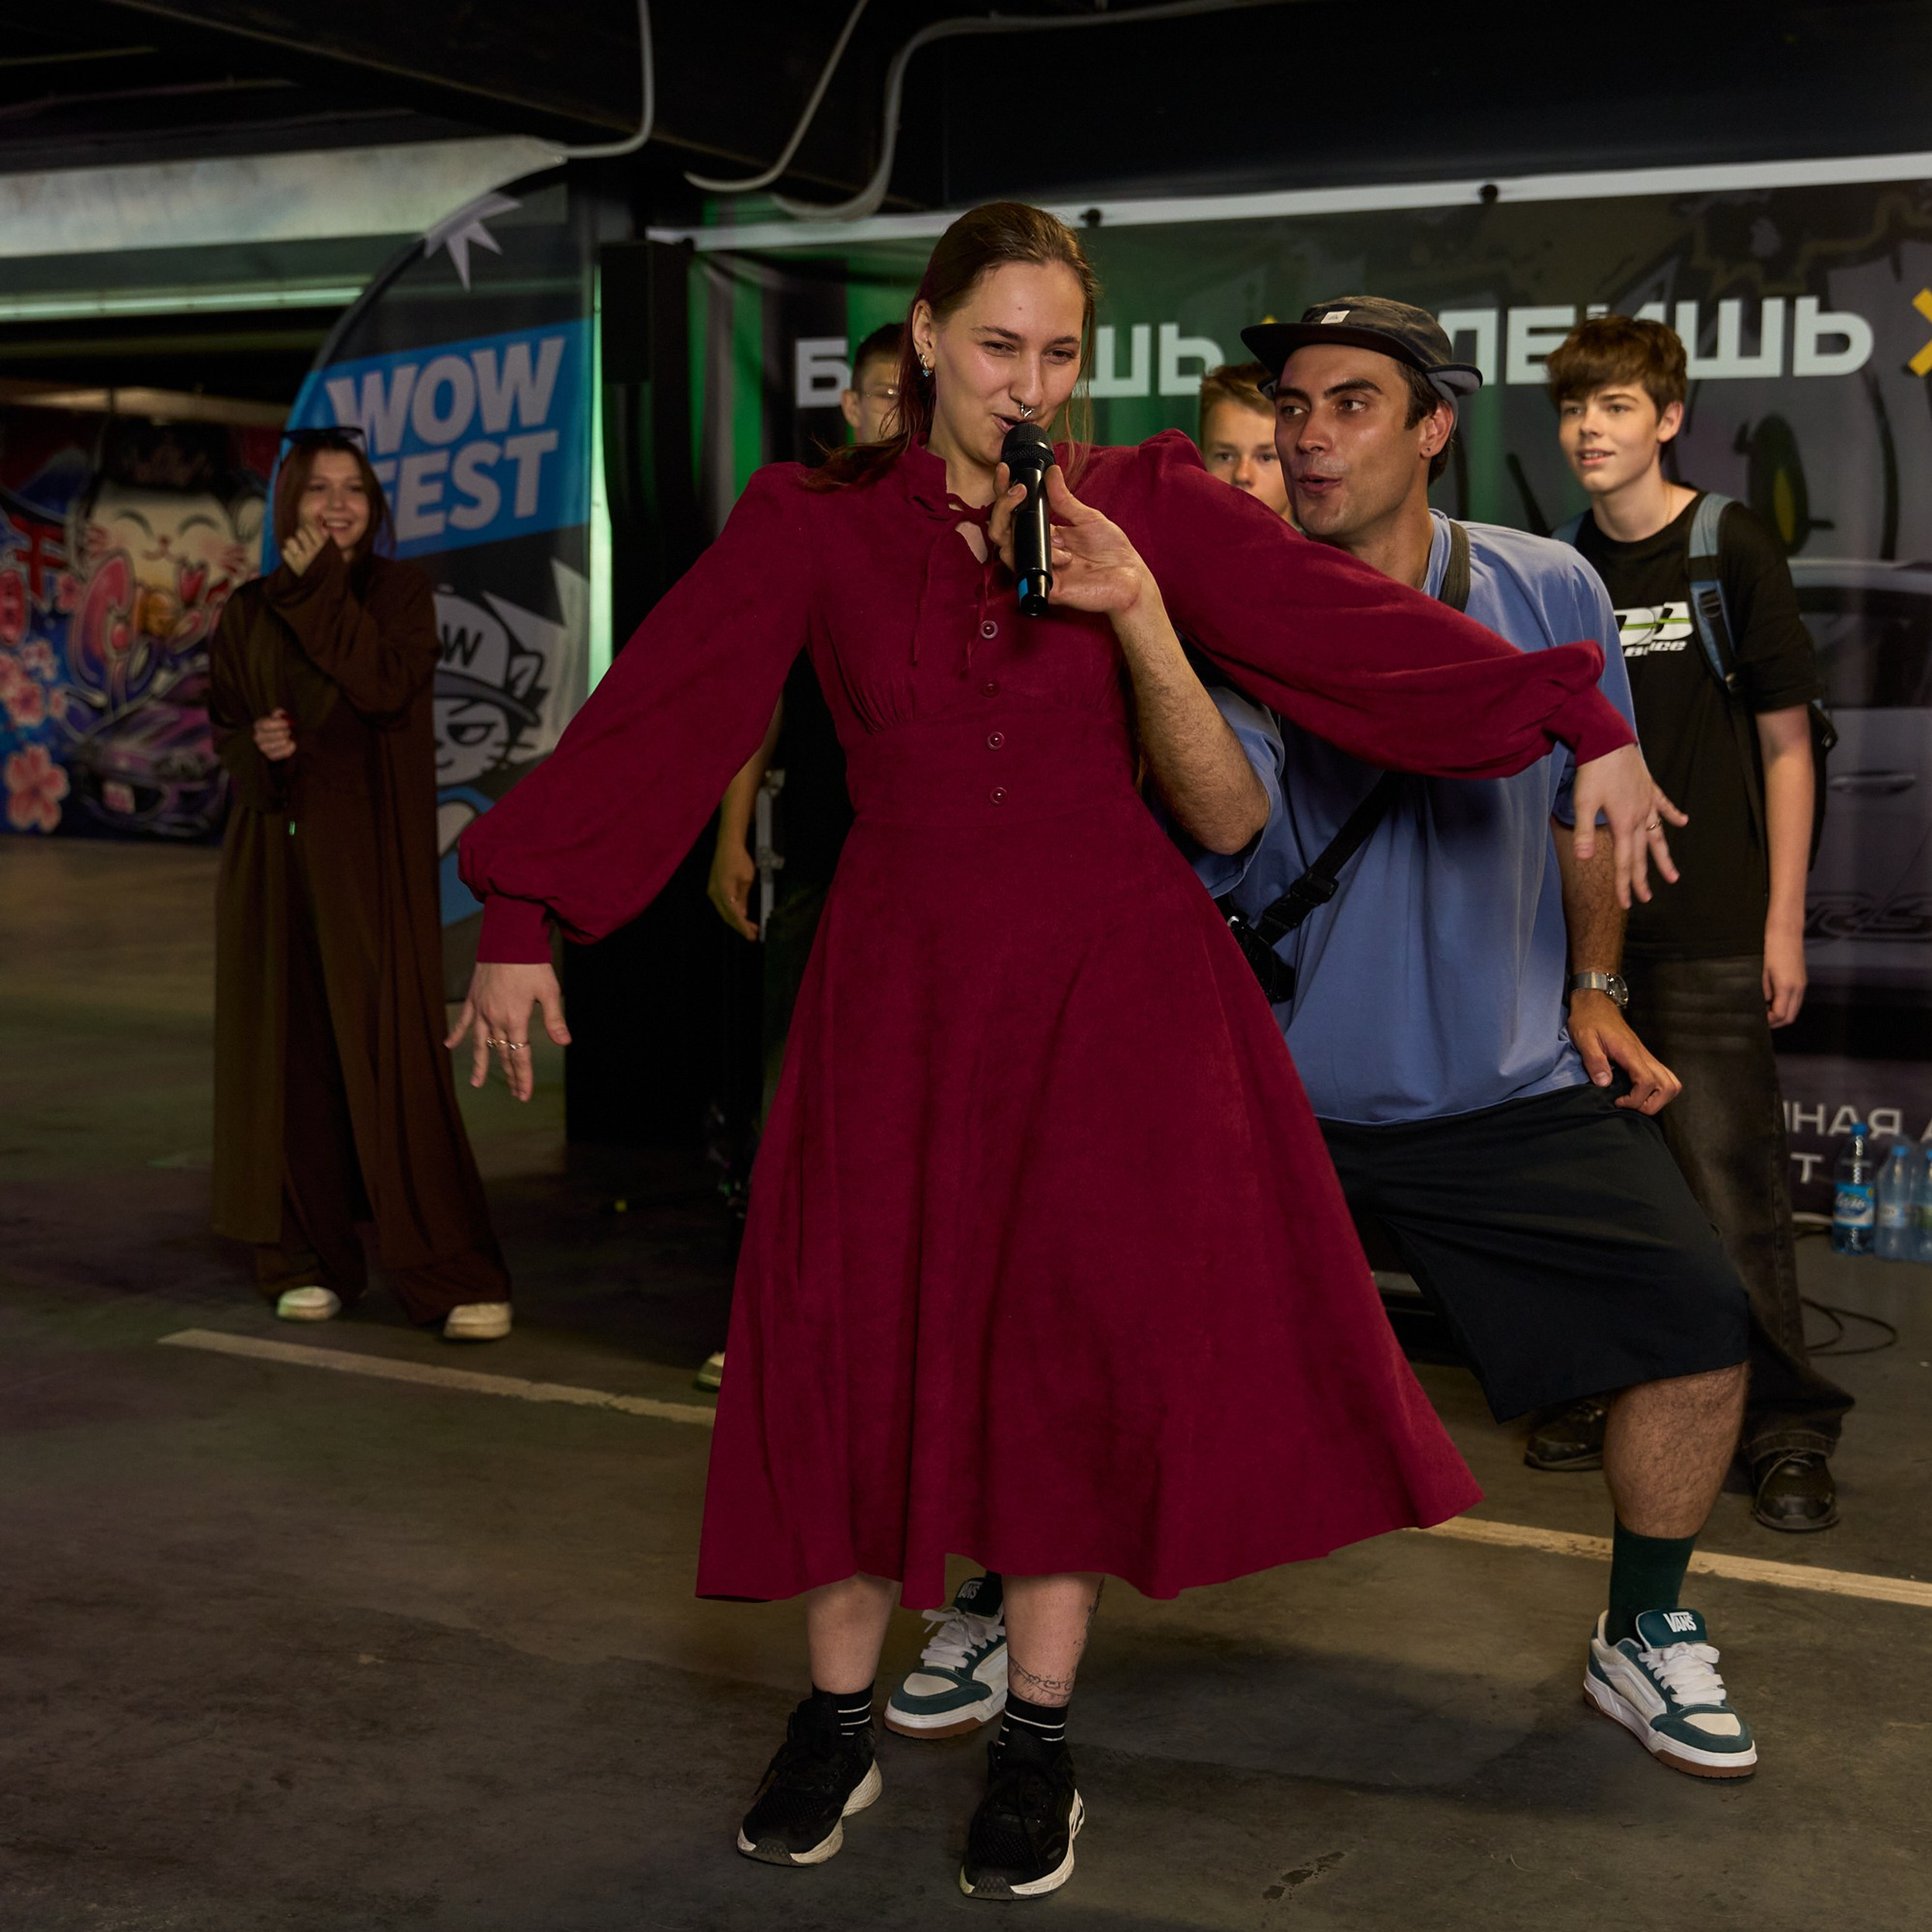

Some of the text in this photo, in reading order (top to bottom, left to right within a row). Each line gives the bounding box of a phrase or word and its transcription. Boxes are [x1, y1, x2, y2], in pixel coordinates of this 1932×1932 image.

[325, 335, 566, 454] WOW
[1783, 1100, 1903, 1141] НАЯ
[1663, 1611, 1697, 1633] VANS
